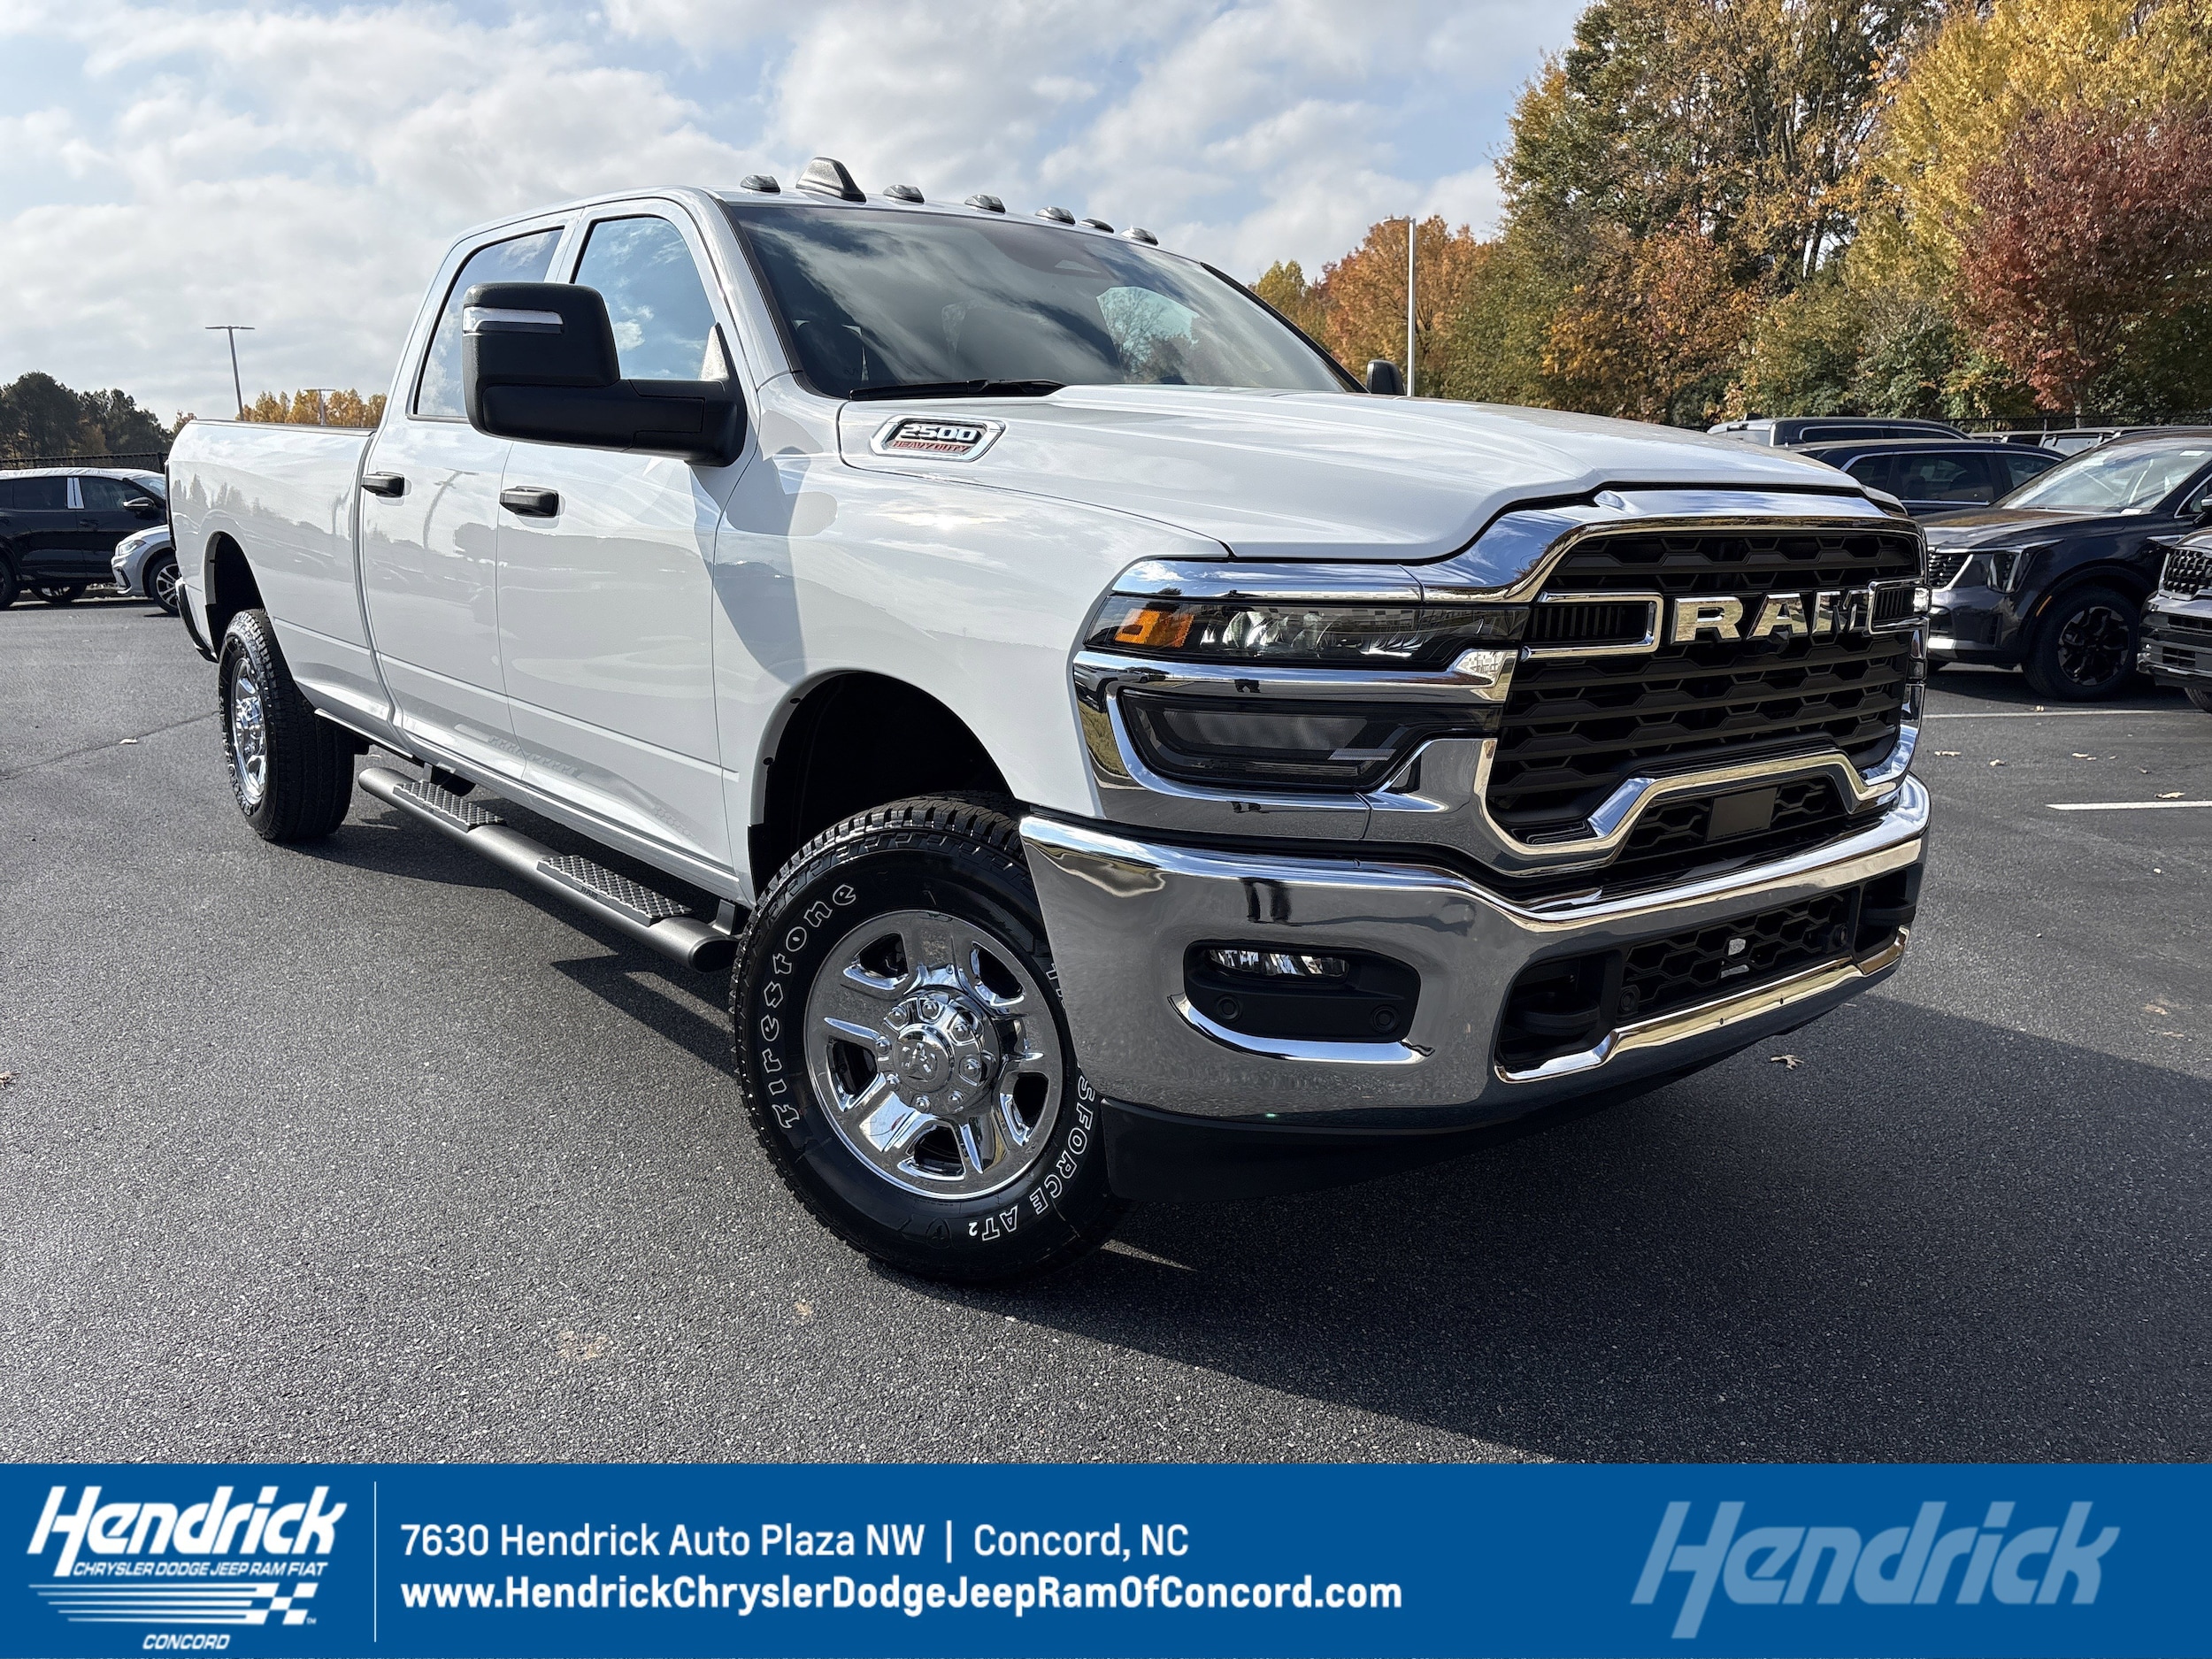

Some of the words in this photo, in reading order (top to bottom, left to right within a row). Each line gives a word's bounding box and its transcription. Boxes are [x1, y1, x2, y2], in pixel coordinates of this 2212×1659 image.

[892, 441, 933, 449] HEAVY
[933, 443, 972, 452] DUTY
[900, 424, 978, 442] 2500
[1671, 590, 1869, 644] RAM
[760, 884, 857, 1130] Firestone
